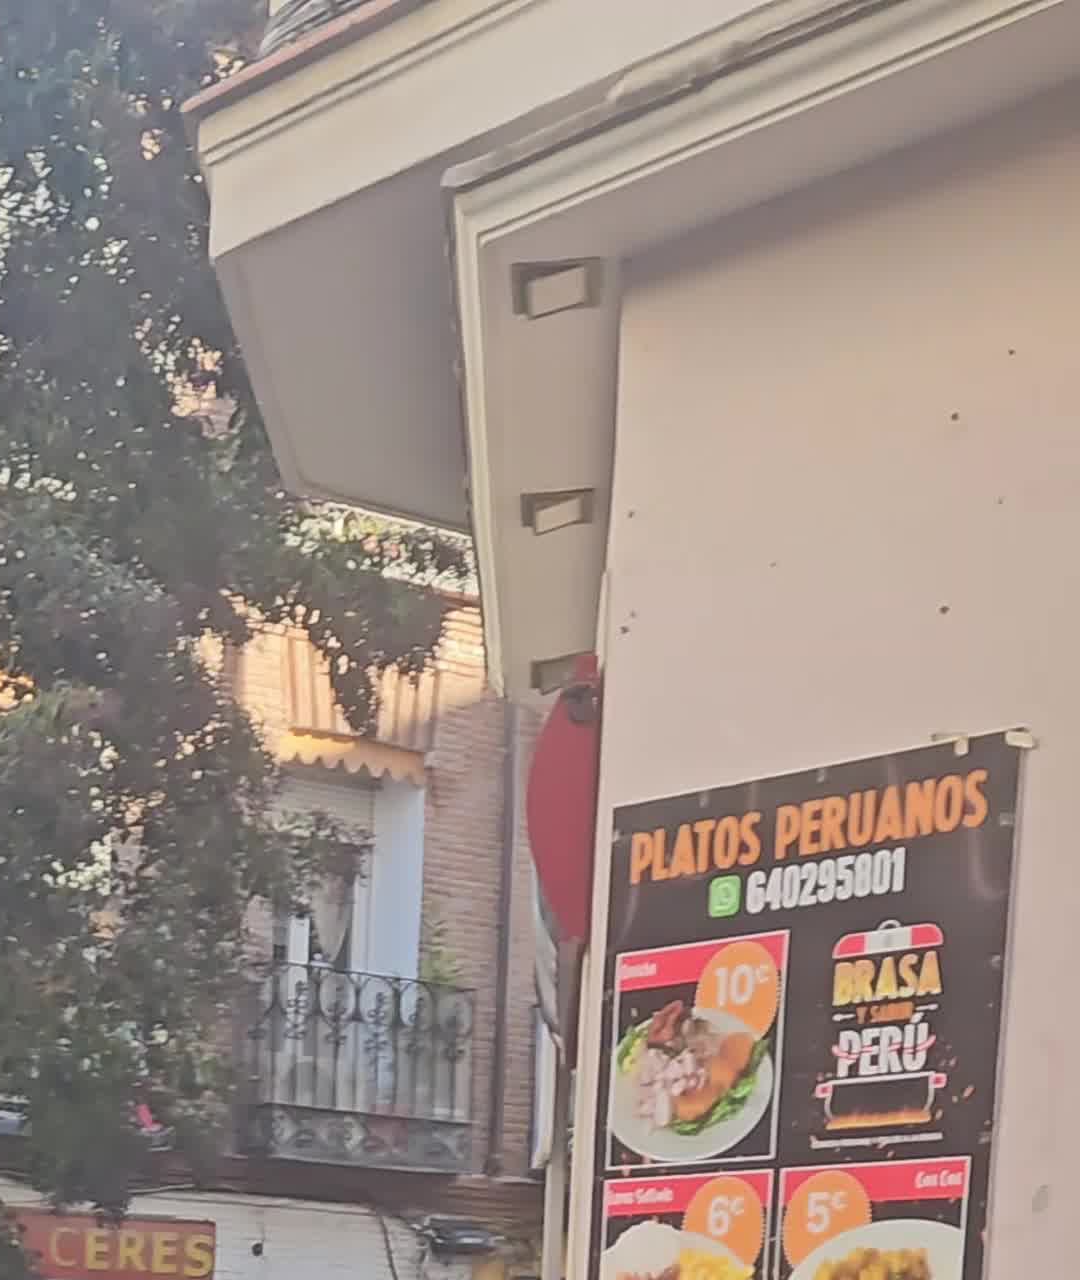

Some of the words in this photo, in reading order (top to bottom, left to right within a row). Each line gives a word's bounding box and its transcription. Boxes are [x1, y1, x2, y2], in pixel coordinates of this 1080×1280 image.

[630, 811, 761, 885] PLATOS
[775, 770, 988, 860] PERUANOS
[746, 847, 905, 914] 640295801
[832, 950, 942, 1007] BRASA
[837, 1011, 929, 1077] PERÚ
[49, 1226, 214, 1280] CERES
